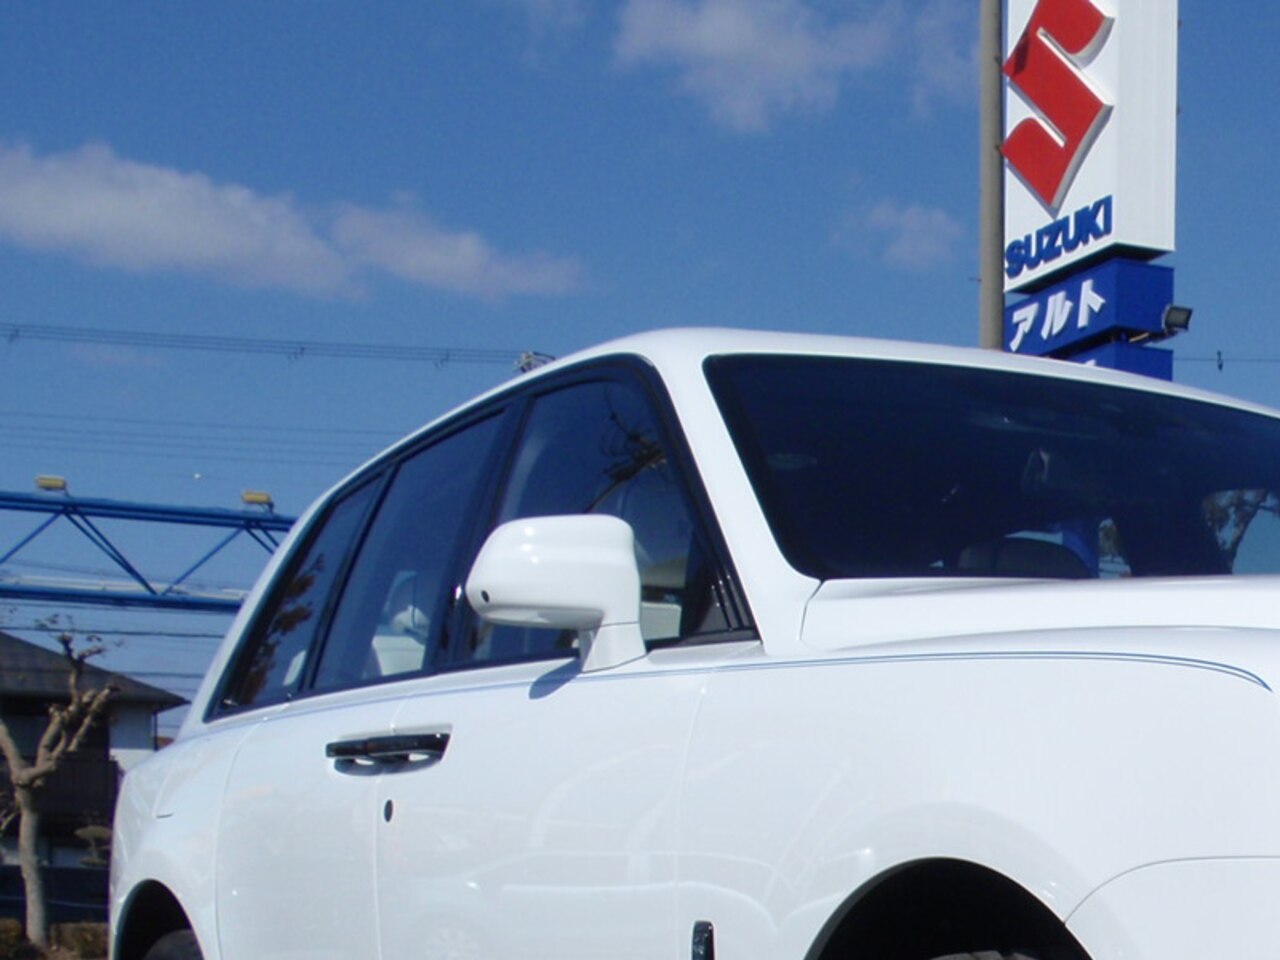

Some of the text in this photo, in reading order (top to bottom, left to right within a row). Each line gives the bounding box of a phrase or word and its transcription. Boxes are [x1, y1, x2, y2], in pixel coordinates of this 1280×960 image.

[1005, 195, 1112, 279] SUZUKI
[1010, 279, 1105, 352] アルト
